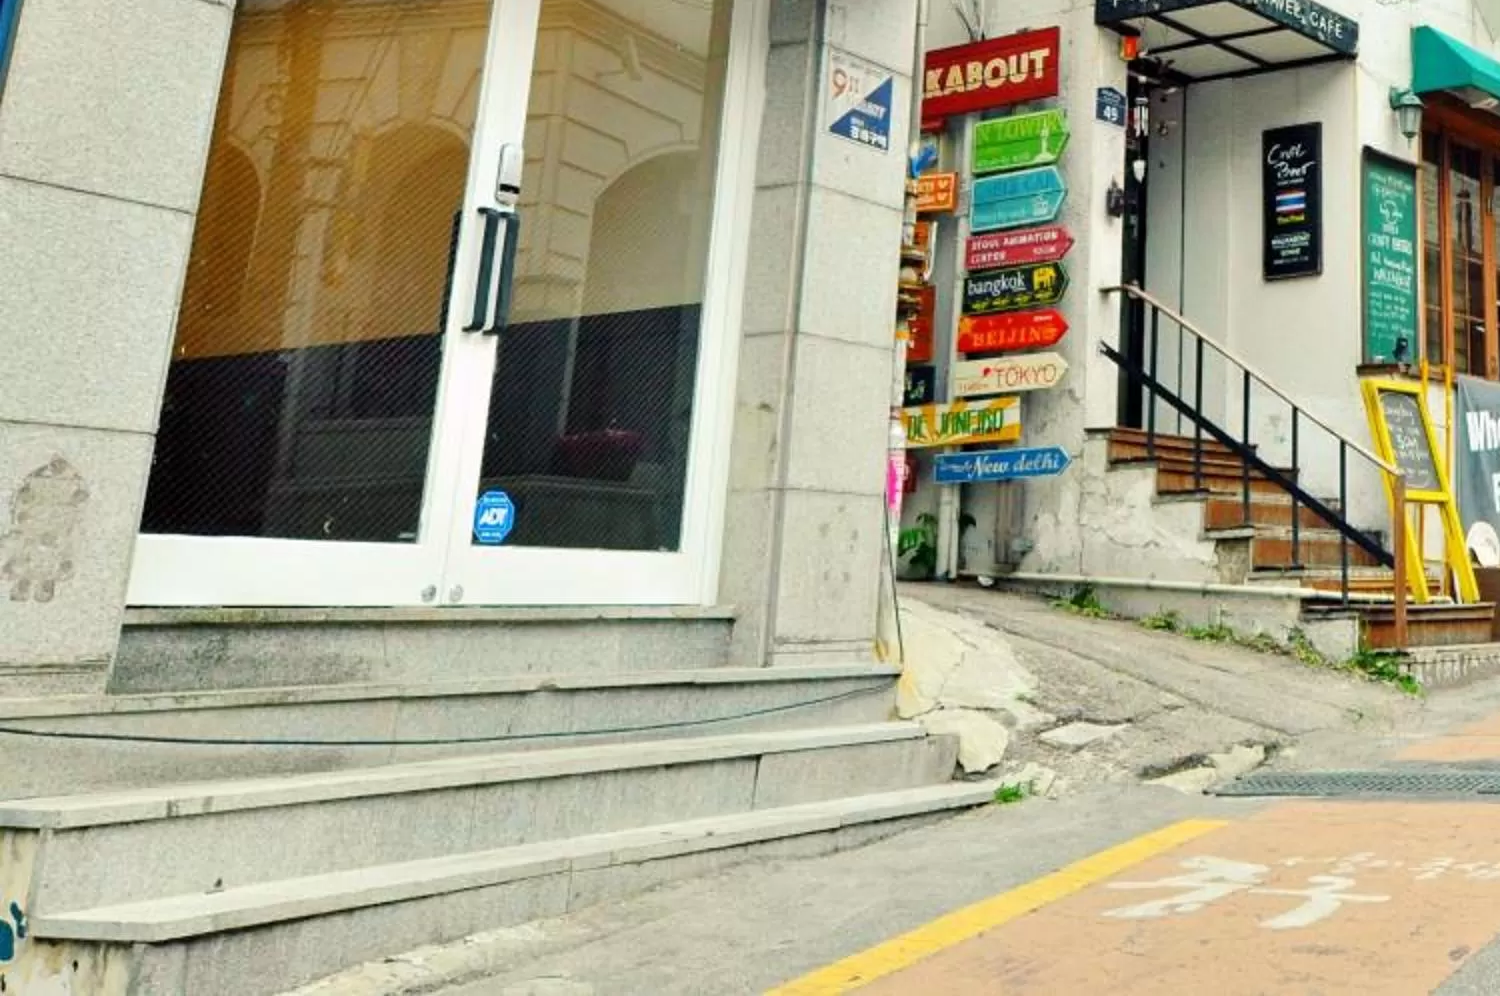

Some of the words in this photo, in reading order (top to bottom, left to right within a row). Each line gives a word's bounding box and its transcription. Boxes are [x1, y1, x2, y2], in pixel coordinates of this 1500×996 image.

[1308, 11, 1345, 40] CAFE
[967, 271, 1026, 297] bangkok
[972, 324, 1057, 348] BEIJING
[995, 363, 1057, 389] TOKYO
[969, 455, 1008, 479] New
[479, 507, 508, 526] ADT
